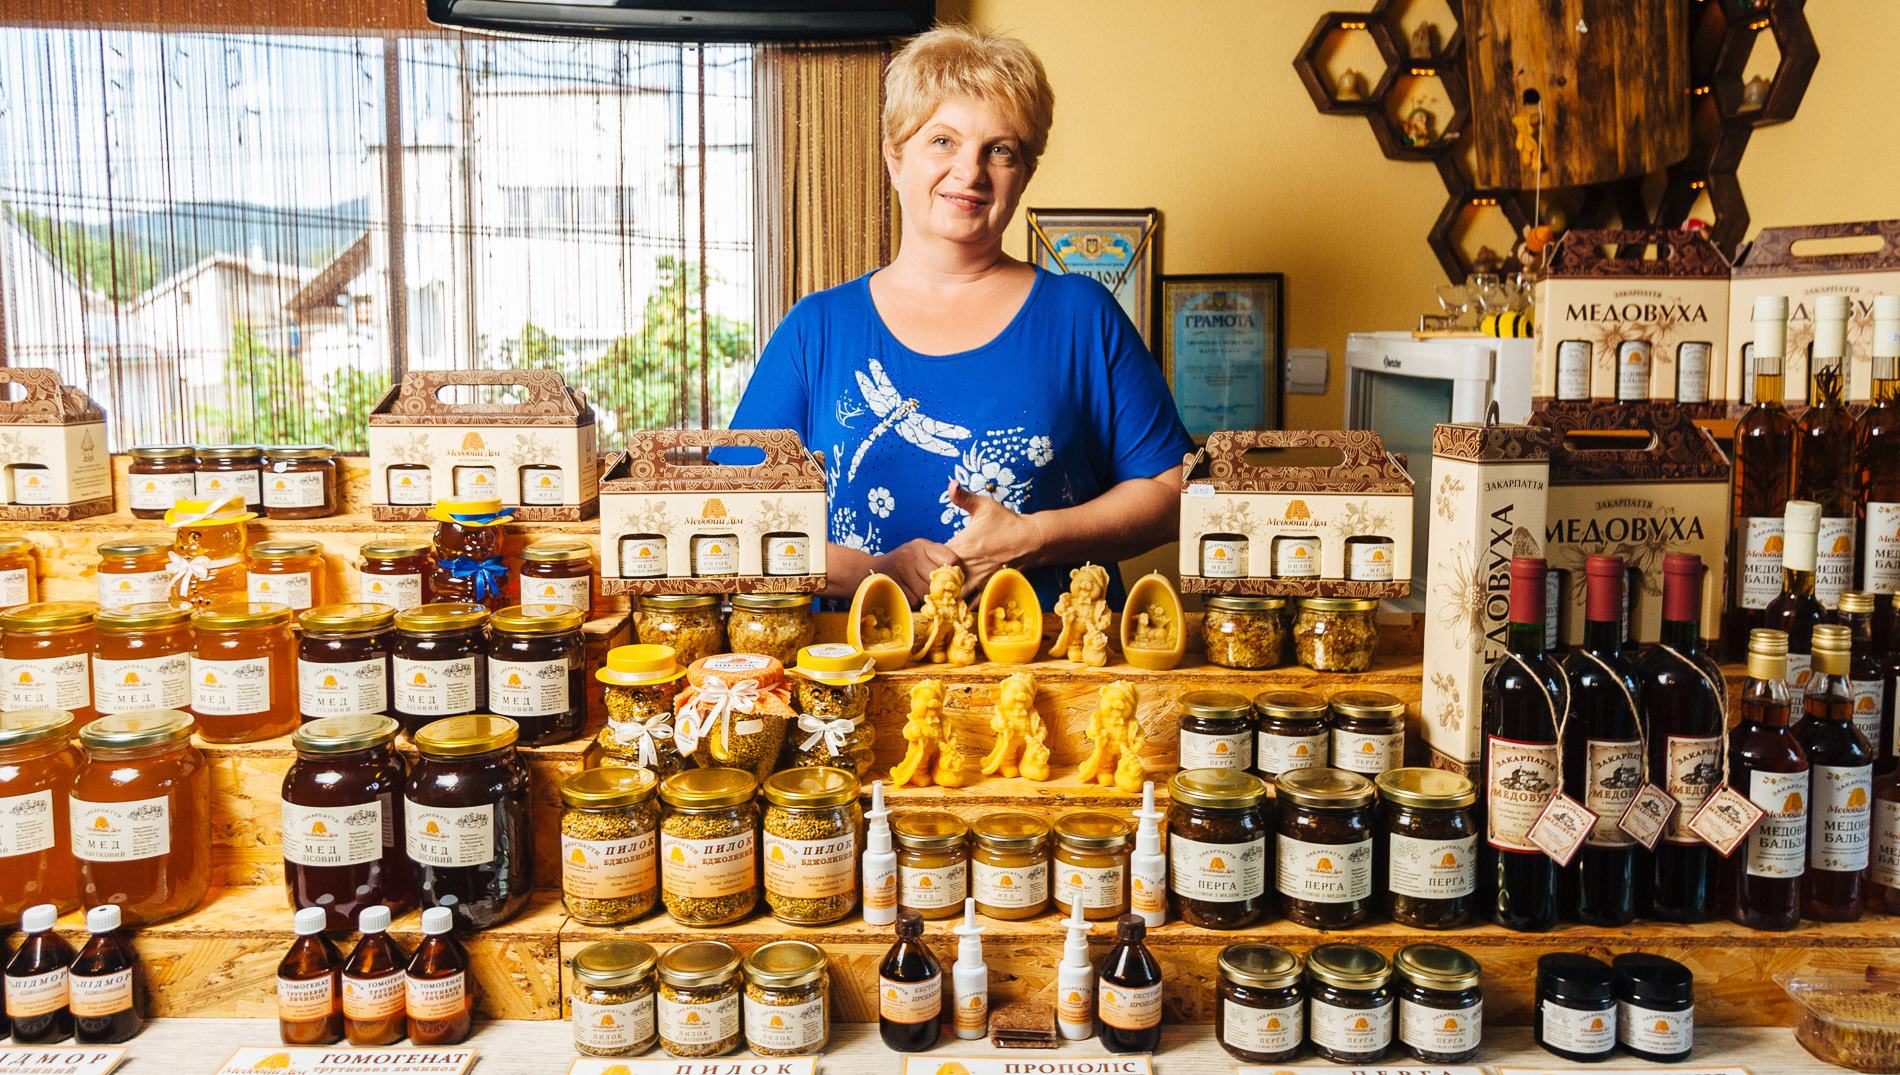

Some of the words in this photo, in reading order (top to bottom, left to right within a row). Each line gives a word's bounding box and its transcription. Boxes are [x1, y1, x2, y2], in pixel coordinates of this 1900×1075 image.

[1613, 288, 1662, 300] ЗАКАРПАТТЯ
[1566, 303, 1709, 324] МЕДОВУХА
[1185, 314, 1255, 329] ГРАМОТА
[1486, 477, 1543, 492] ЗАКАРПАТТЯ
[1595, 497, 1651, 511] ЗАКАРПАТТЯ
[726, 516, 745, 526] Дім
[1310, 518, 1328, 528] Дім
[1545, 516, 1703, 544] МЕДОВУХА
[1744, 564, 1783, 574] МЕДО
[1484, 503, 1515, 678] ЕДОВУХА
[13, 693, 44, 703] МЕД
[117, 694, 151, 703] МЕД
[200, 694, 226, 704] МЕД
[317, 697, 348, 706] МЕД
[408, 695, 435, 704] МЕД
[502, 696, 531, 705] МЕД
[1209, 759, 1234, 767] ПЕРГА
[1290, 761, 1313, 769] ПЕРГА
[1355, 759, 1380, 767] ПЕРГА
[1496, 755, 1556, 772] ЗАКАРПАТТЯ
[1708, 806, 1742, 836] МЕДОВУХА
[1545, 815, 1577, 843] МЕДОВУХА
[87, 840, 121, 850] МЕД
[304, 845, 337, 855] МЕД
[420, 843, 449, 856] МЕД
[604, 836, 655, 856] ПИЛОК
[703, 836, 753, 855] ПИЛОК
[802, 840, 853, 856] ПИЛОК
[1430, 844, 1465, 856] ЗАКАРПАТТЯ
[301, 855, 342, 863] ЛІСОВИЙ
[418, 854, 453, 864] ЛІСОВИЙ
[603, 847, 656, 867] БДЖОЛИНИЙ
[702, 847, 754, 866] БДЖОЛИНИЙ
[801, 851, 854, 867] БДЖОЛИНИЙ
[1199, 849, 1237, 860] ЗАКАРПАТТЯ
[1305, 849, 1344, 860] ЗАКАРПАТТЯ
[1198, 880, 1237, 890] ПЕРГА
[1305, 880, 1344, 891] ПЕРГА
[1428, 876, 1465, 887] ПЕРГА
[15, 970, 67, 989] ПІДМОР
[80, 972, 132, 989] ПІДМОР
[286, 979, 330, 991] ГОМОГЕНАТ
[420, 976, 463, 990] ГОМОГЕНАТ
[286, 987, 329, 998] ТРУТНЕВИХ
[421, 984, 462, 996] ТРУТНЕВИХ
[424, 990, 460, 1001] ЛИЧИНОК
[289, 993, 326, 1002] ЛИЧИНОК
[593, 1033, 624, 1041] ПИЛОК
[1259, 1036, 1286, 1045] ПЕРГА
[1347, 1036, 1375, 1044] ПЕРГА
[319, 1053, 469, 1065] ГОМОГЕНАТ
[313, 1066, 393, 1074] трутневих
[676, 1063, 796, 1075] ПИЛОК
[1004, 1062, 1138, 1074] ПРОПОЛІС
